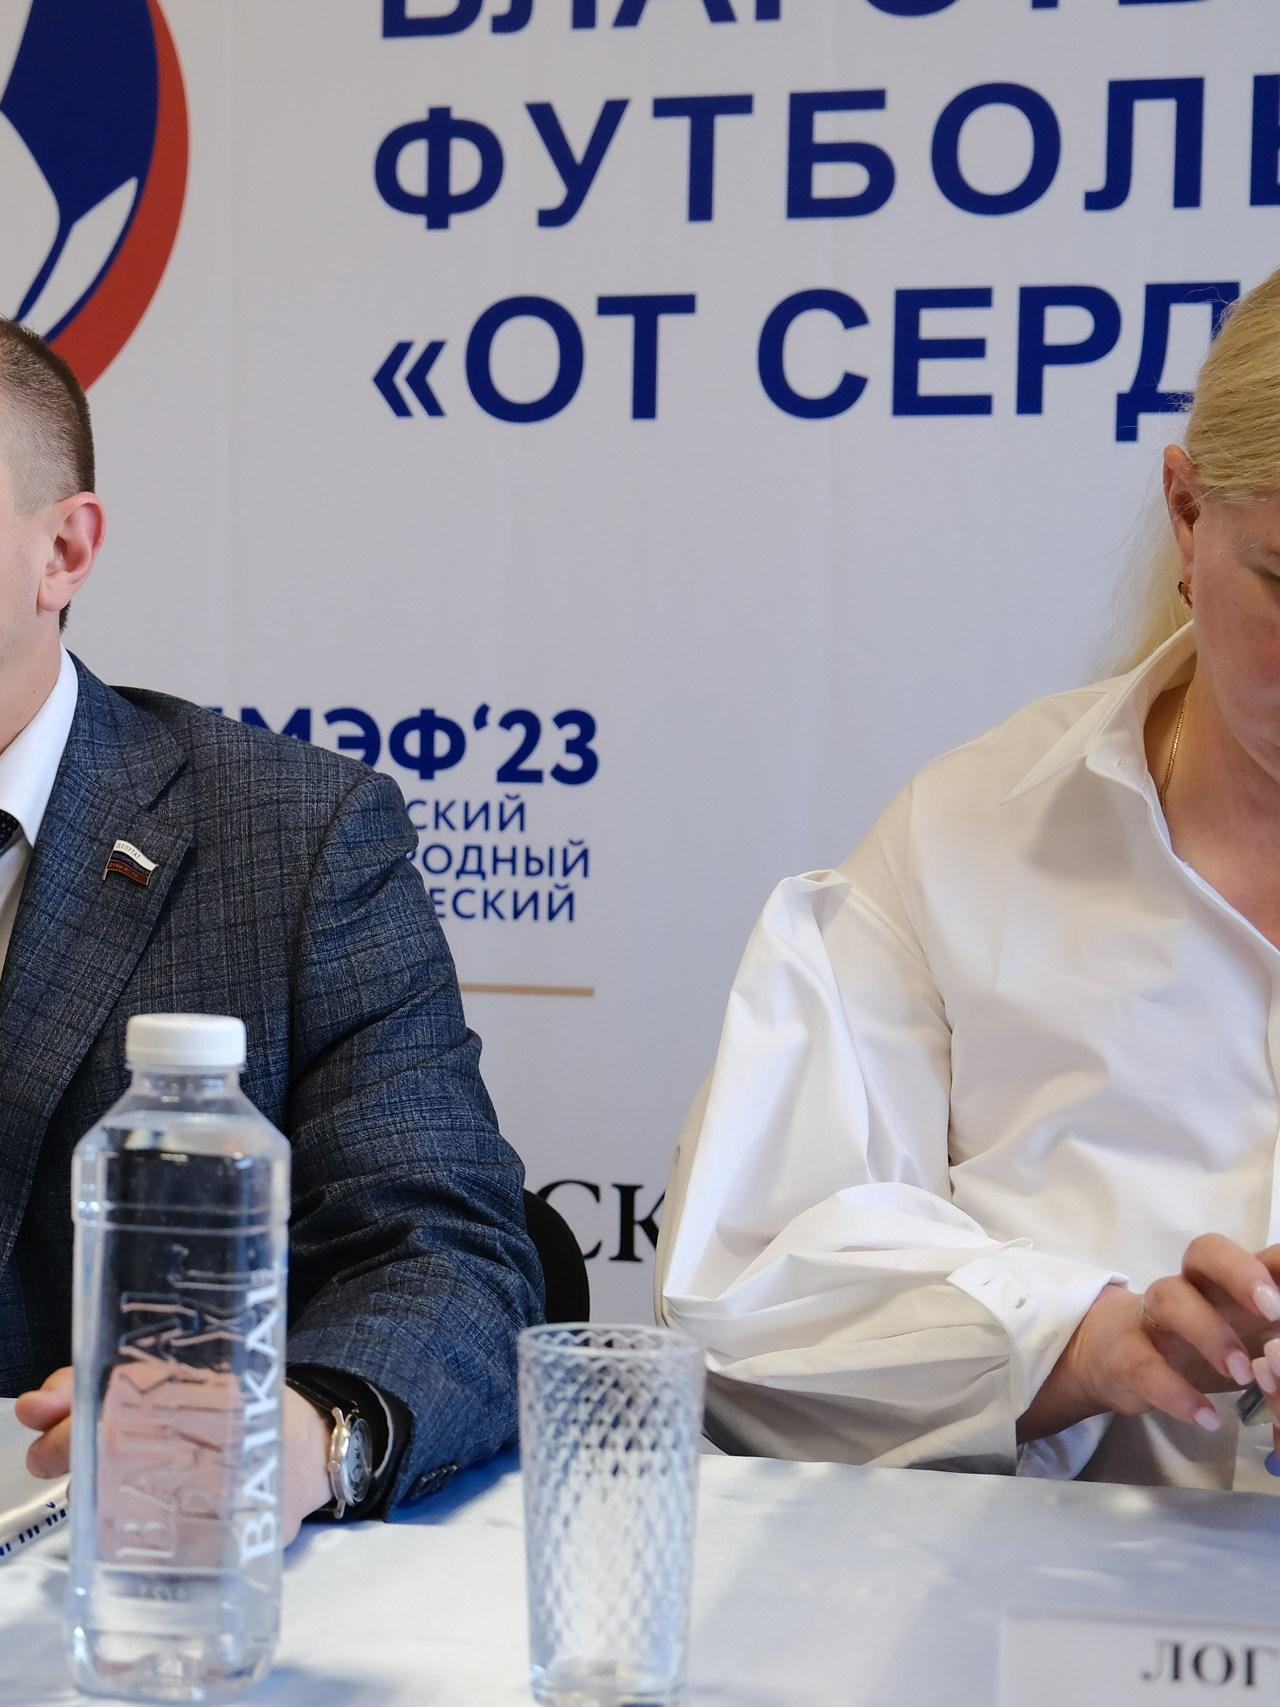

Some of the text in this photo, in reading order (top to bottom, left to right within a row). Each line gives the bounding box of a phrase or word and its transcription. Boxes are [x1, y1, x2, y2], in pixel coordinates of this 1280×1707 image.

[373, 72, 1280, 231] ФУТБОЛ
[372, 292, 697, 424] «ОТ
[406, 838, 591, 881] ОДНЫЙ
